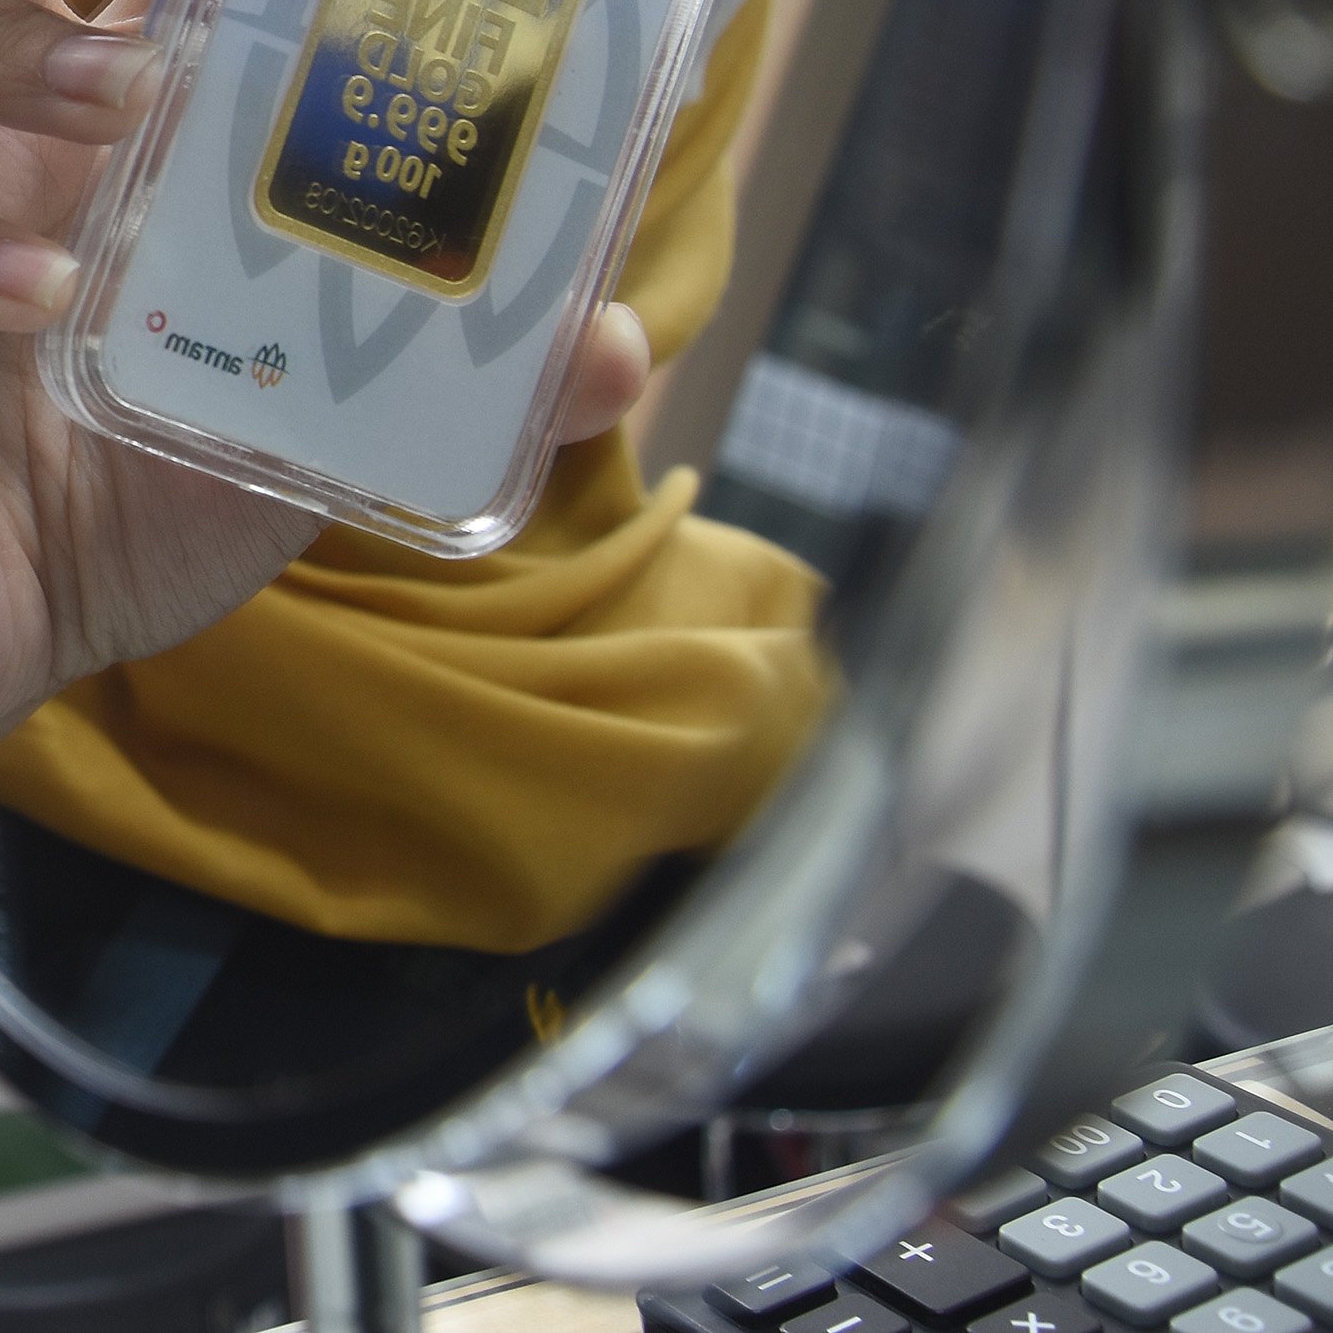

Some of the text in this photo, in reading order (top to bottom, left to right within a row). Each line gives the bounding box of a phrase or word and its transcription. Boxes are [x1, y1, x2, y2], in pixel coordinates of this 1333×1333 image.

[1152, 1089, 1192, 1109] 0
[1235, 1130, 1273, 1150] 1
[1136, 1169, 1182, 1193] 2
[1042, 1215, 1085, 1237] 3
[1226, 1212, 1274, 1239] 5
